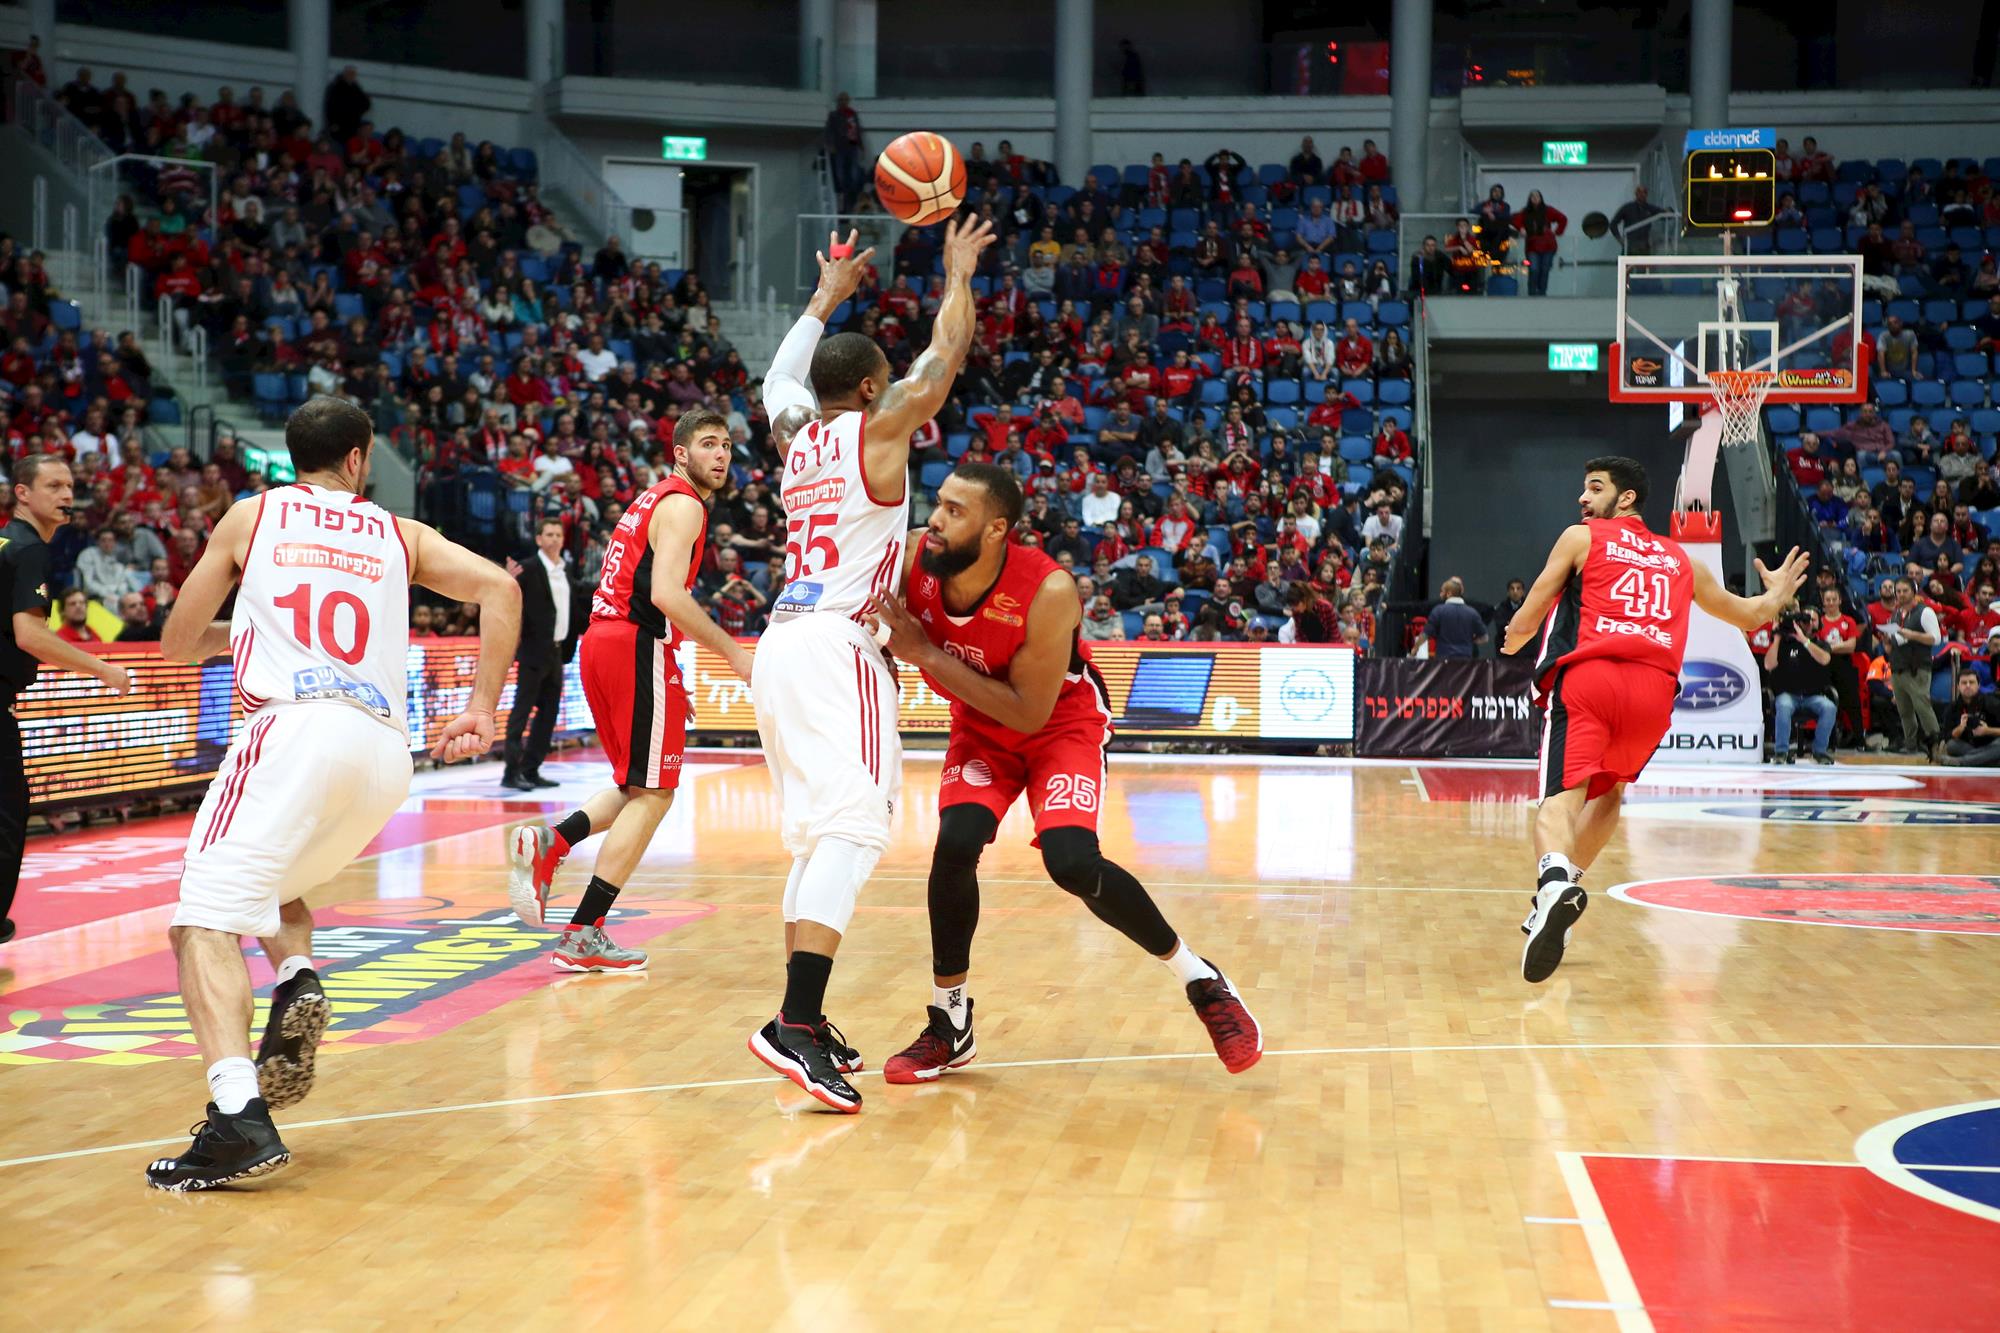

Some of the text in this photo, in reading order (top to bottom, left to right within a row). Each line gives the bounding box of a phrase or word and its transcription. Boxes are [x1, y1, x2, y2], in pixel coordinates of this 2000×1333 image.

[1547, 143, 1583, 163] יציאה
[1553, 347, 1593, 368] יציאה
[280, 501, 385, 540] הלפרין
[275, 546, 383, 577] תלפיות החדשה
[785, 513, 839, 584] 55
[1611, 567, 1672, 620] 41
[273, 583, 370, 666] 10
[1366, 696, 1529, 720] ארומה אספרסו בר
[1659, 733, 1758, 750] UBARU
[1044, 773, 1097, 813] 25
